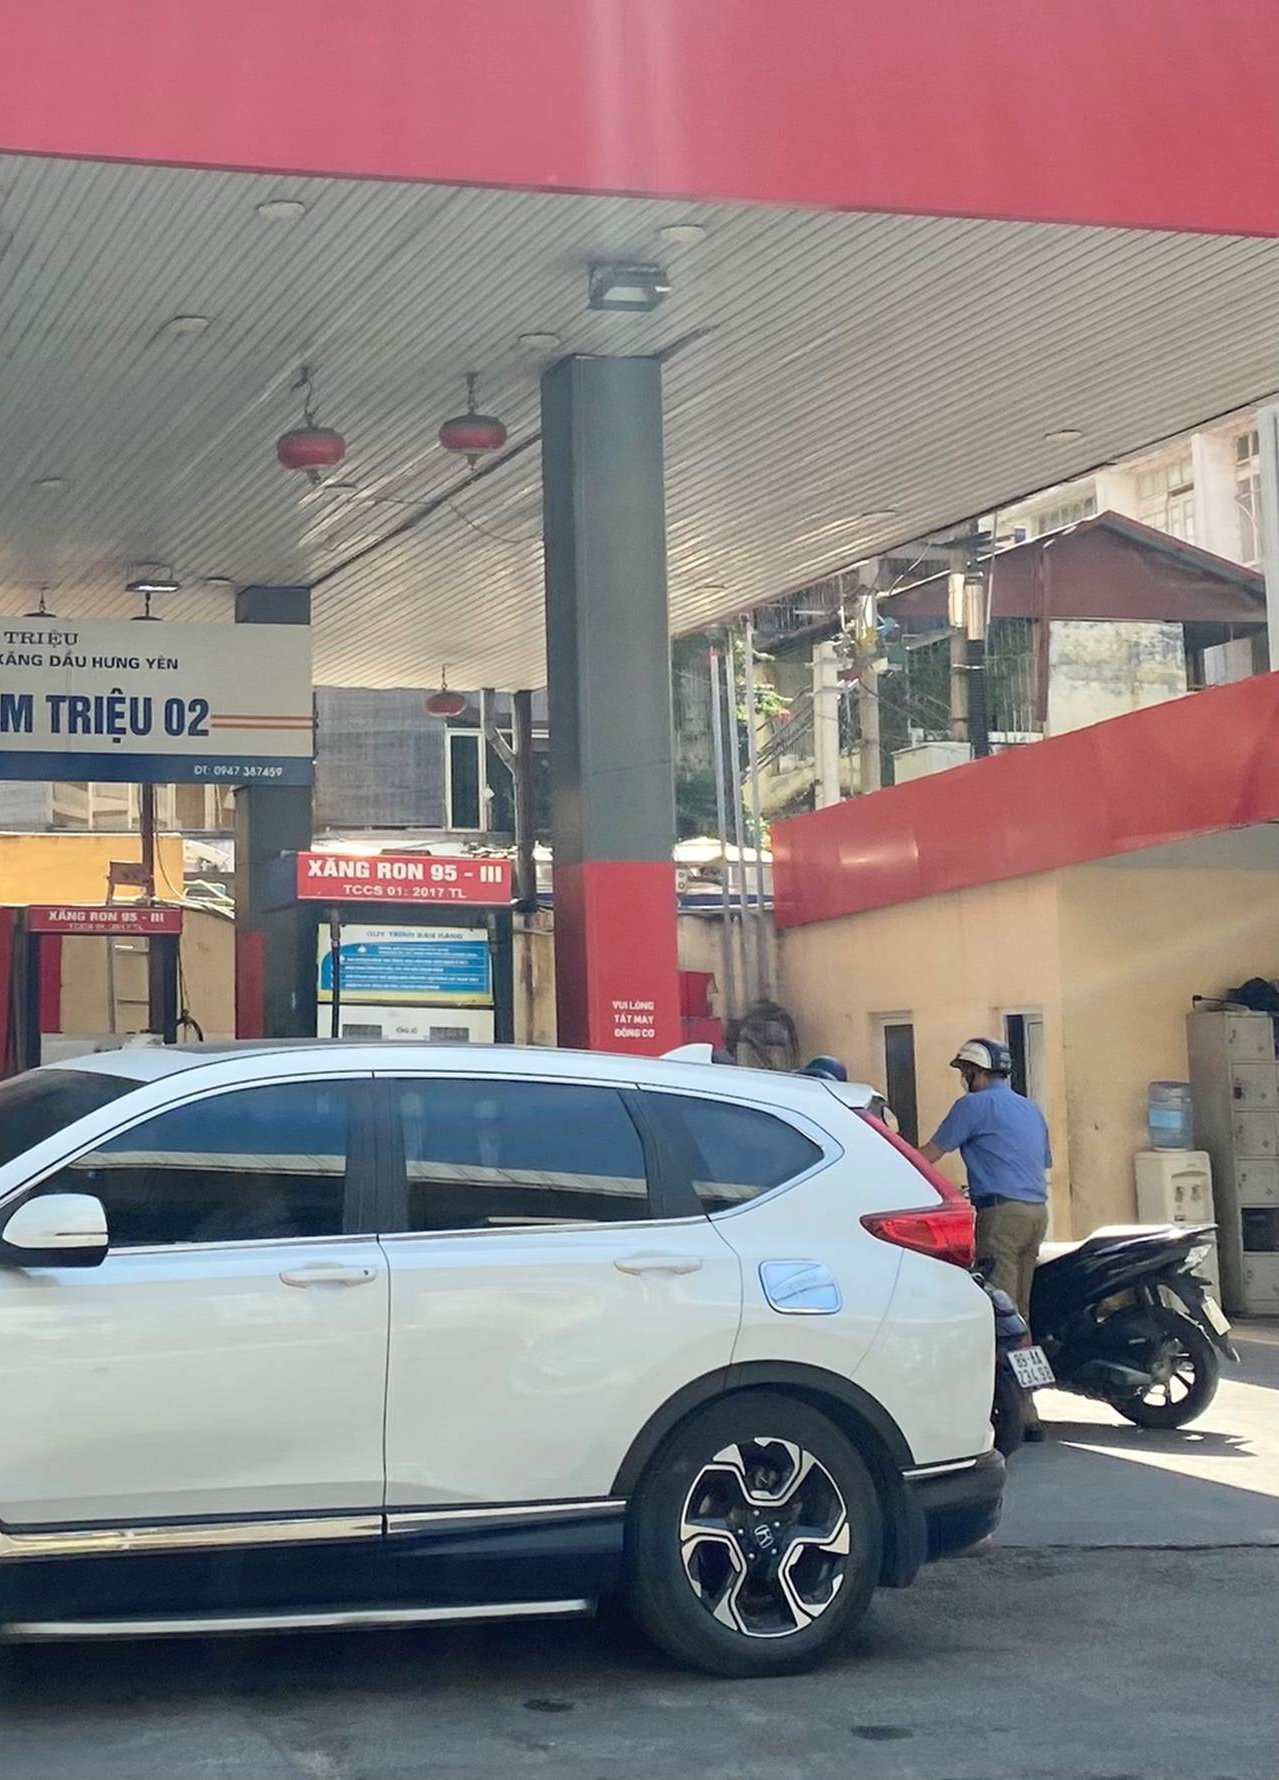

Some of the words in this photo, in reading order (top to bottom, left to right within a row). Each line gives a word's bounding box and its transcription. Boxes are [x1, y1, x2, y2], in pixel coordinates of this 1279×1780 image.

[4, 628, 80, 649] TRIỆU
[49, 649, 87, 668] DẦU
[92, 655, 141, 669] HƯNG
[146, 654, 179, 670] YÊN
[45, 687, 153, 744] TRIỆU
[164, 697, 210, 737] 02
[213, 765, 241, 776] 0947
[307, 857, 370, 879] XĂNG
[377, 861, 423, 881] RON
[430, 864, 458, 882] 95
[479, 865, 503, 883] III
[343, 884, 383, 896] TCCS
[413, 887, 445, 898] 2017
[449, 888, 467, 899] TL
[48, 909, 86, 922] XĂNG
[89, 912, 118, 923] RON
[611, 1000, 628, 1010] VUI
